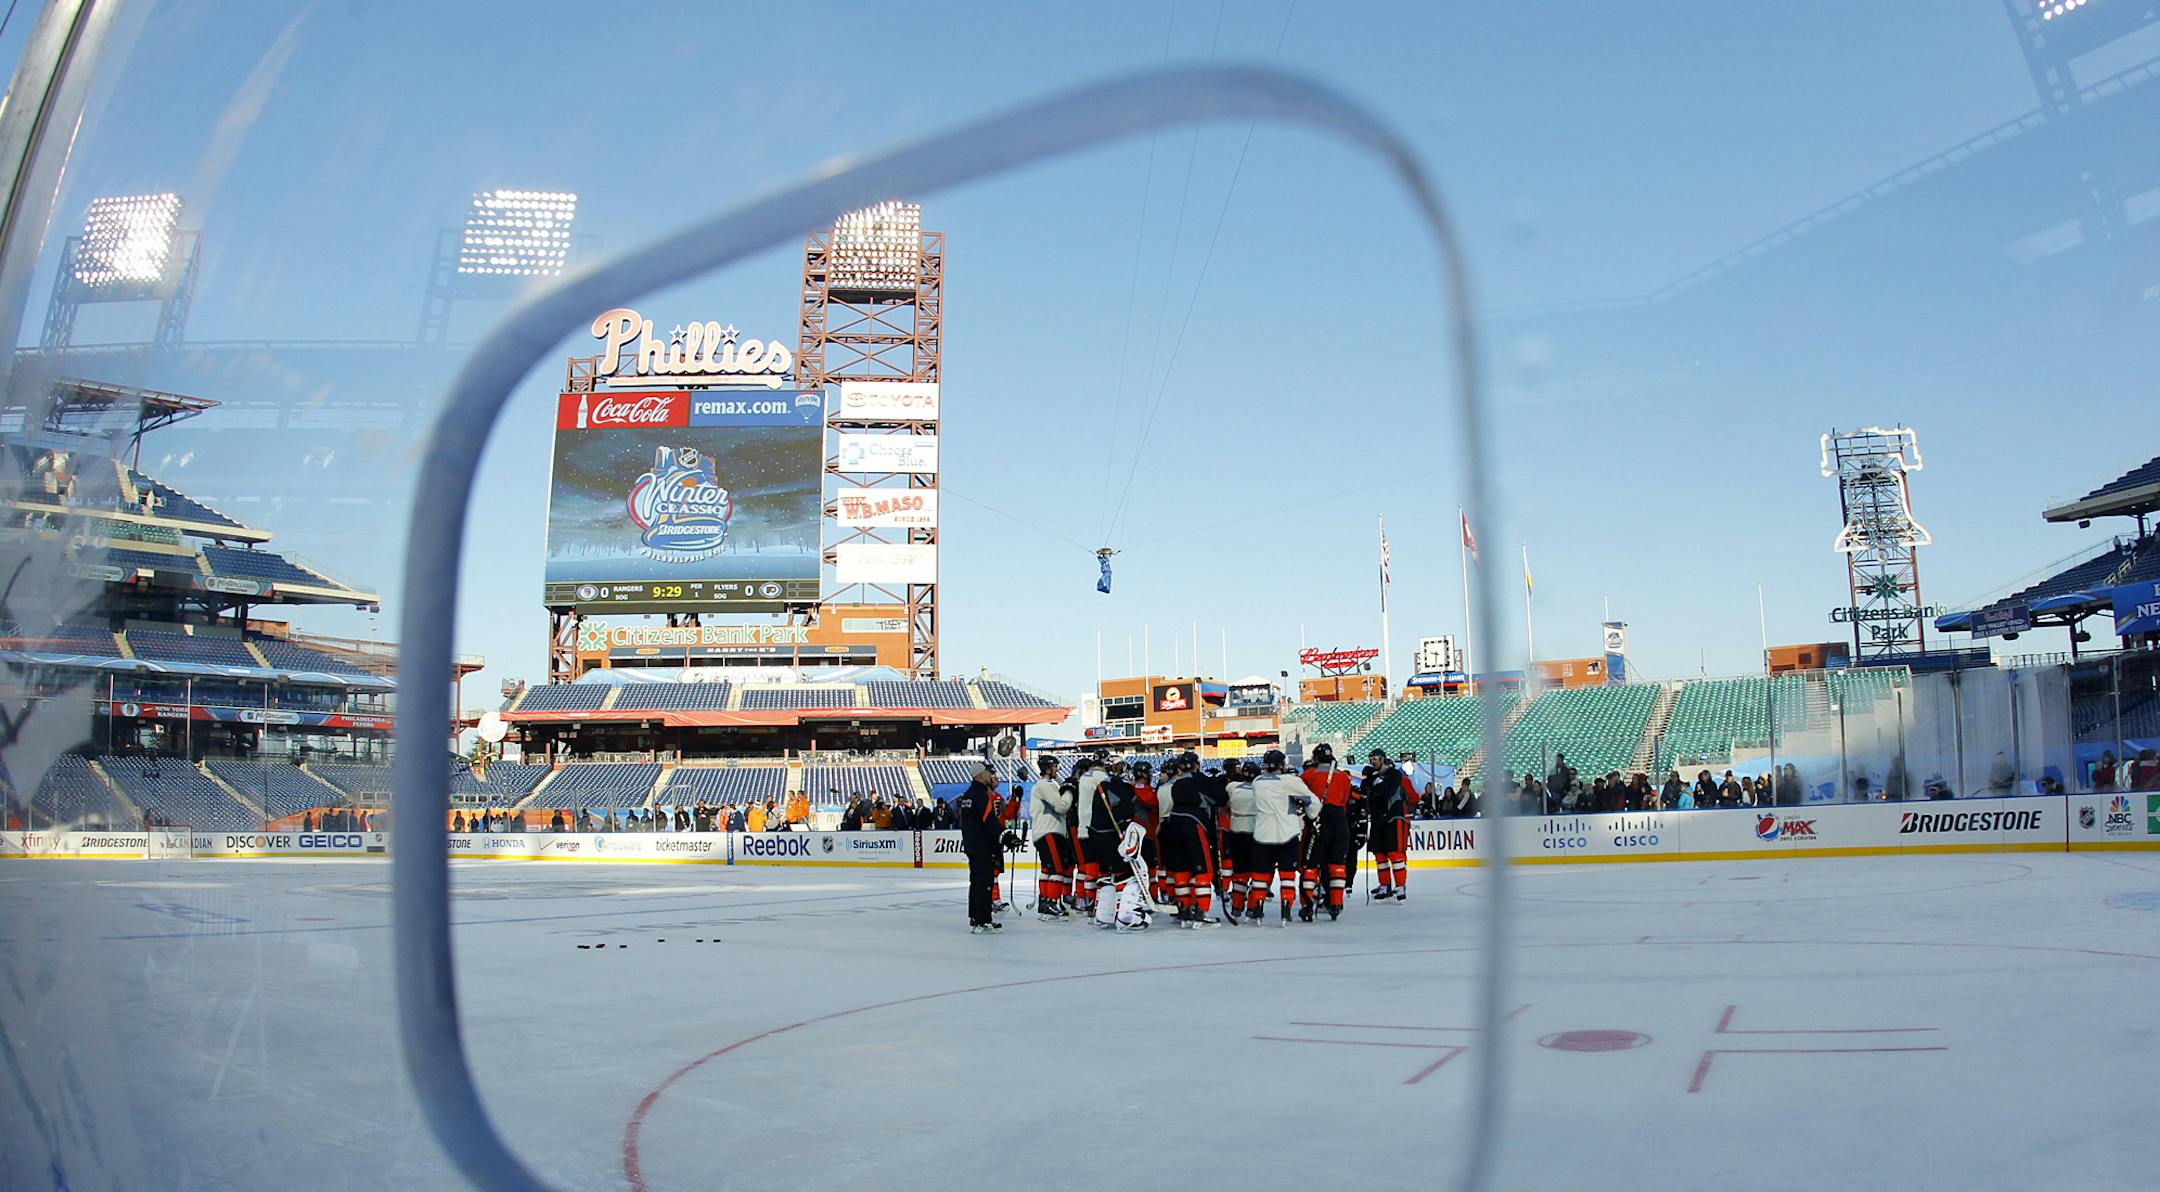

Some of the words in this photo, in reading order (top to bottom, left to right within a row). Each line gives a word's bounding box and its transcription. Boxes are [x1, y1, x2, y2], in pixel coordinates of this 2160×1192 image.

[591, 308, 793, 375] Phillies
[592, 396, 676, 424] Coca-Cola
[695, 399, 788, 414] remax.com
[636, 470, 729, 519] Winter
[656, 502, 724, 514] CLASSIC
[657, 525, 722, 536] BRIDGESTONE
[600, 586, 609, 599] 0
[613, 585, 644, 593] RANGERS
[653, 586, 682, 598] 9:29
[713, 583, 738, 591] FLYERS
[745, 584, 754, 597] 0
[1832, 606, 1901, 623] Citizens
[1903, 604, 1945, 619] Bank
[611, 625, 698, 647] Citizens
[701, 624, 756, 644] Bank
[760, 623, 810, 643] Park
[1872, 624, 1908, 640] Park
[1900, 810, 2043, 833] BRIDGESTONE
[2108, 813, 2132, 824] NBC
[1780, 819, 1818, 836] MAX
[2105, 821, 2135, 833] Sports
[82, 834, 148, 848] BRIDGESTONE
[226, 835, 291, 848] DISCOVER
[299, 834, 363, 848] GEICO
[492, 839, 525, 848] HONDA
[556, 840, 580, 850] verizon
[656, 837, 713, 852] ticketmaster
[743, 835, 811, 856] Reebok
[1406, 830, 1474, 850] ANADIAN
[1543, 837, 1587, 848] CISCO
[1614, 835, 1659, 847] CISCO
